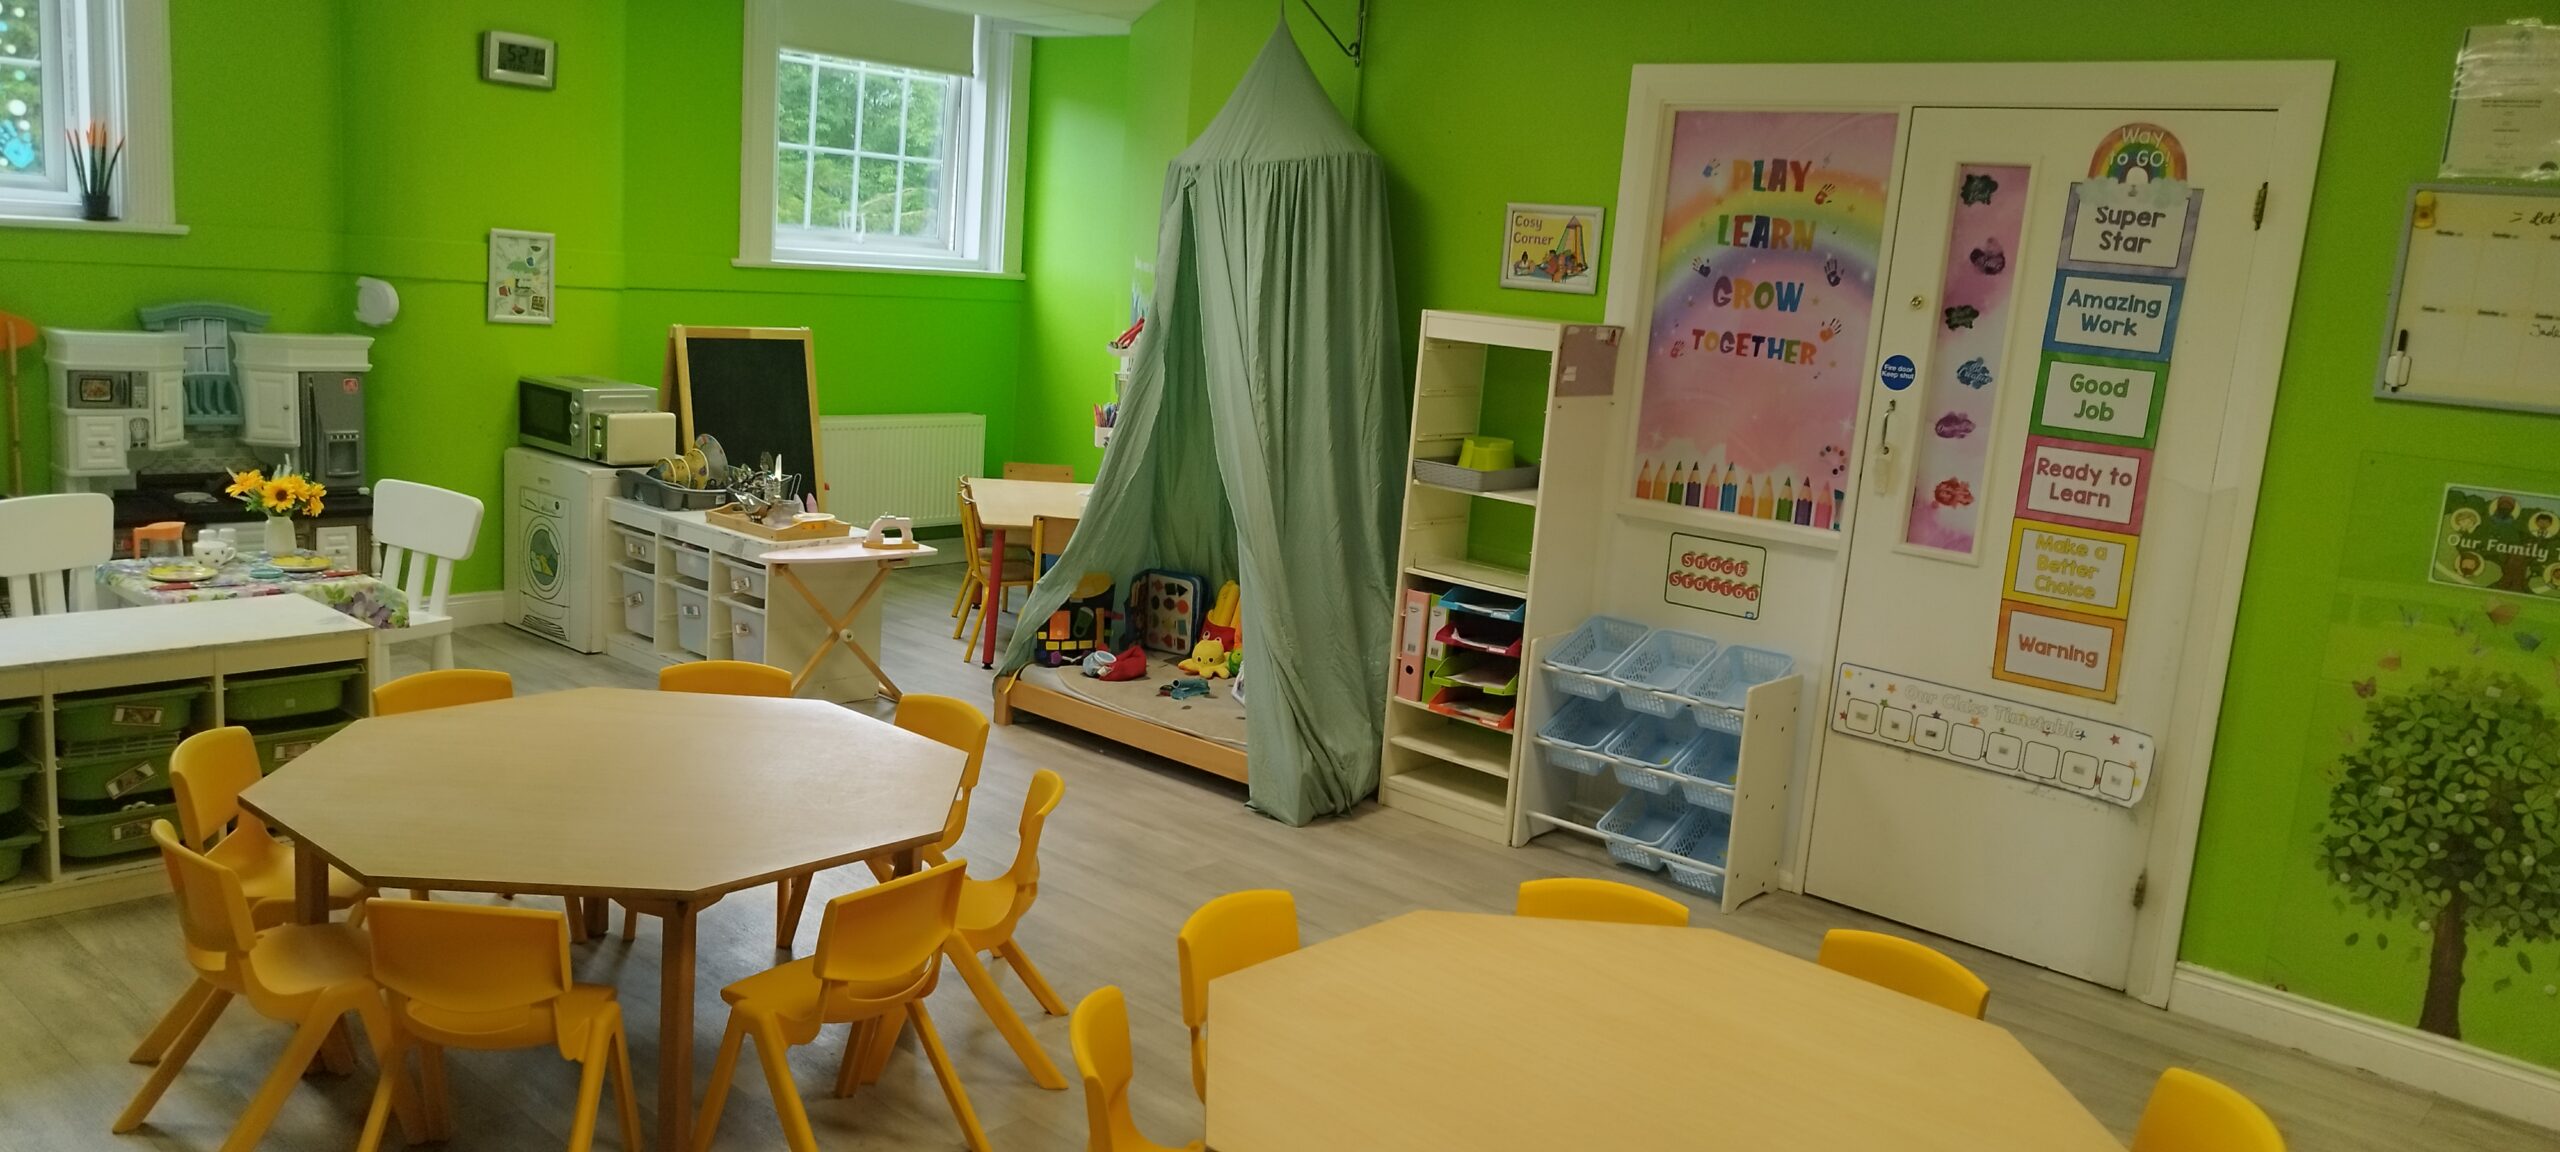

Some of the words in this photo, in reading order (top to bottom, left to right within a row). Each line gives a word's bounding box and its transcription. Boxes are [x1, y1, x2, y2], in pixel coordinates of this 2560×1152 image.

[2122, 127, 2165, 149] Way
[1732, 159, 1813, 193] PLAY
[1514, 215, 1543, 232] Cosy
[2095, 206, 2166, 230] Super
[1513, 231, 1555, 246] Corner
[1717, 214, 1817, 252] LEARN
[2099, 230, 2152, 254] Star
[1712, 275, 1805, 313] GROW
[2067, 288, 2162, 319] Amazing
[2081, 312, 2138, 337] Work
[1691, 328, 1818, 366] TOGETHER
[1882, 370, 1899, 380] Keep
[1900, 372, 1915, 380] shut
[1884, 363, 1897, 372] Fire
[1898, 365, 1914, 374] door
[2069, 372, 2130, 398] Good
[2073, 398, 2115, 422] Job
[2036, 457, 2103, 487] Ready
[2110, 466, 2133, 488] to
[2050, 482, 2111, 508] Learn
[2035, 533, 2089, 557] Make
[2094, 545, 2108, 561] a
[2447, 533, 2482, 550] Our
[2486, 538, 2549, 562] Family
[1682, 553, 1746, 577] Snack
[2036, 554, 2099, 580] Better
[1671, 573, 1758, 600] Station
[2034, 575, 2097, 600] Choice
[2018, 633, 2099, 669] Warning
[1903, 684, 1938, 705] Our
[1941, 693, 1988, 720] Class
[1994, 703, 2084, 741] Timetable
